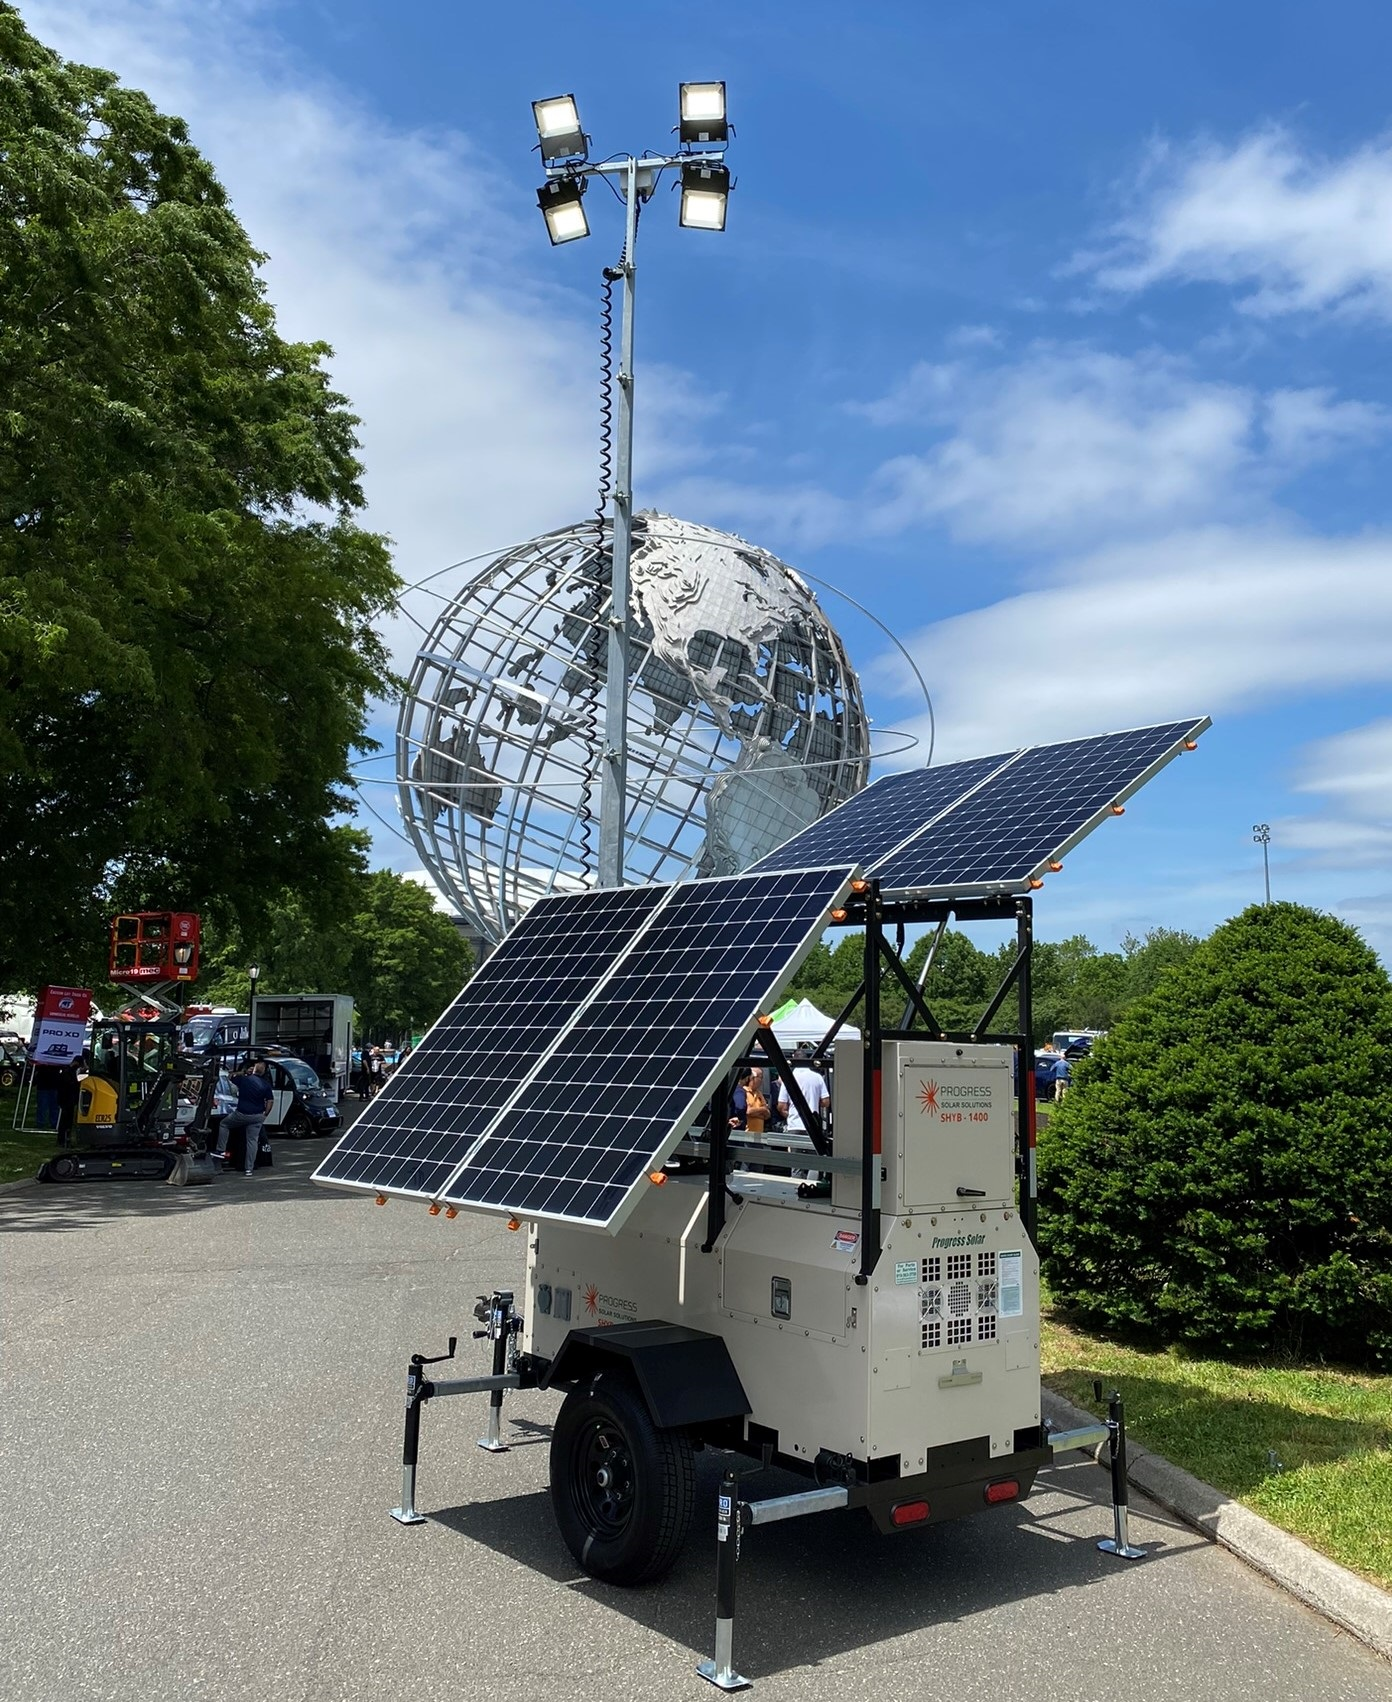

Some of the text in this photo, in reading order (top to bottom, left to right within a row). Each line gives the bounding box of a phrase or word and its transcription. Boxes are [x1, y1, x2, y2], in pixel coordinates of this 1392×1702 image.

[42, 1028, 63, 1037] PRO
[940, 1086, 992, 1097] PROGRESS
[940, 1101, 992, 1109] SOLAR SOLUTIONS
[932, 1233, 986, 1249] Progress Solar
[598, 1294, 638, 1313] PROGRESS
